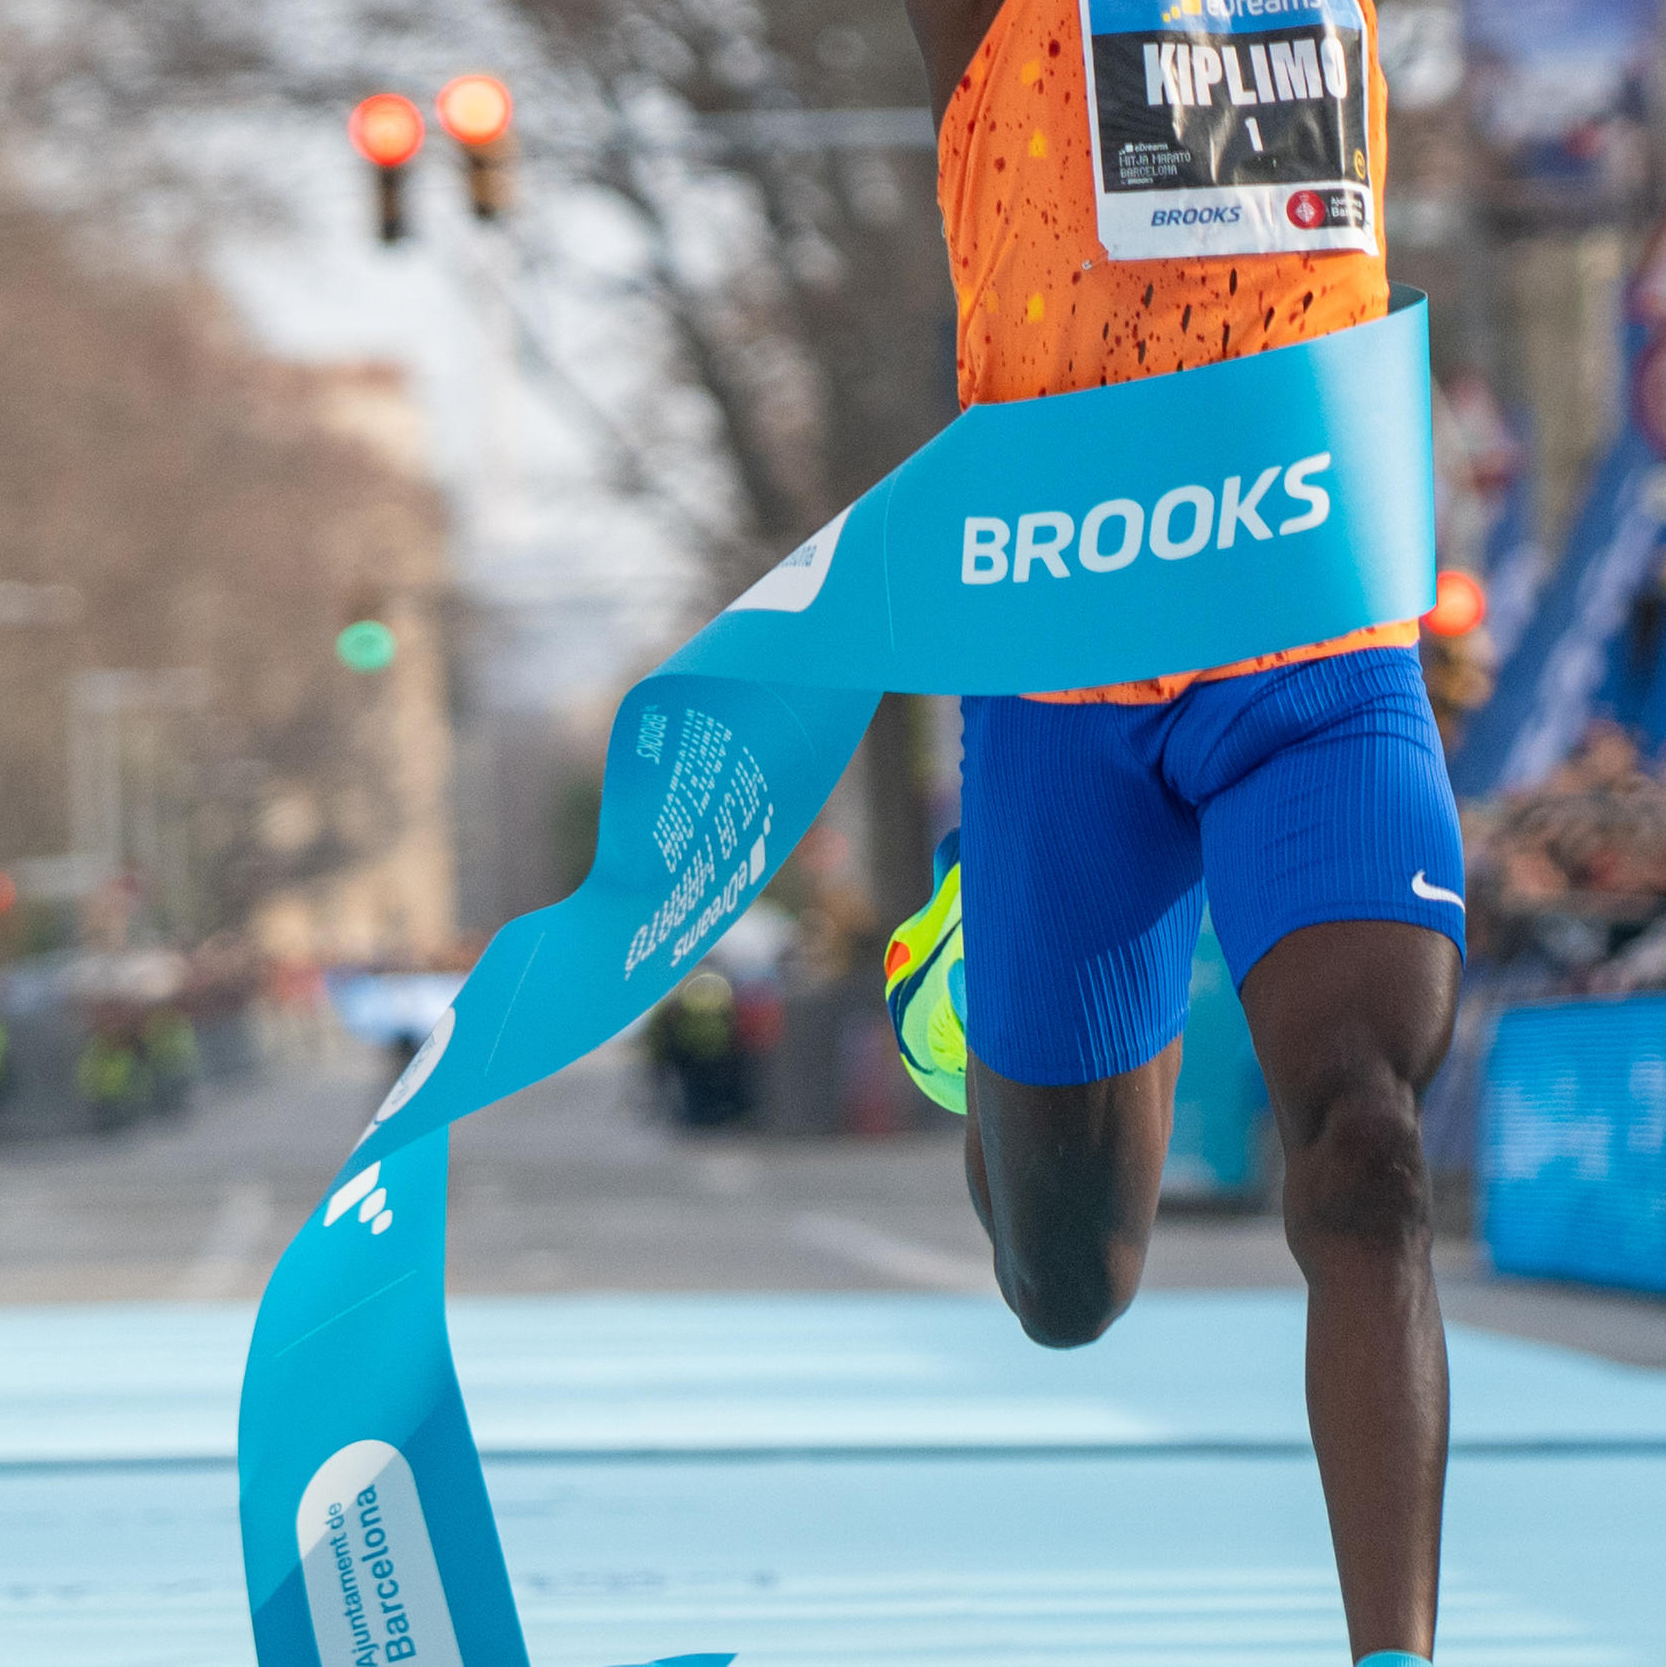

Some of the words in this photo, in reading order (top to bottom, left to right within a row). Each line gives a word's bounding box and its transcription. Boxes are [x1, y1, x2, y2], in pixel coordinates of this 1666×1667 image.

[1143, 36, 1348, 107] KIPLIMO
[1244, 117, 1264, 153] 1
[1120, 164, 1178, 179] BARCELONA
[1150, 205, 1242, 228] BROOKS
[961, 452, 1332, 585] BROOKS
[636, 713, 668, 766] BROOKS
[670, 859, 748, 968] eDreams
[324, 1502, 346, 1531] de
[329, 1531, 380, 1667] Ajuntament
[356, 1484, 417, 1663] Barcelona
